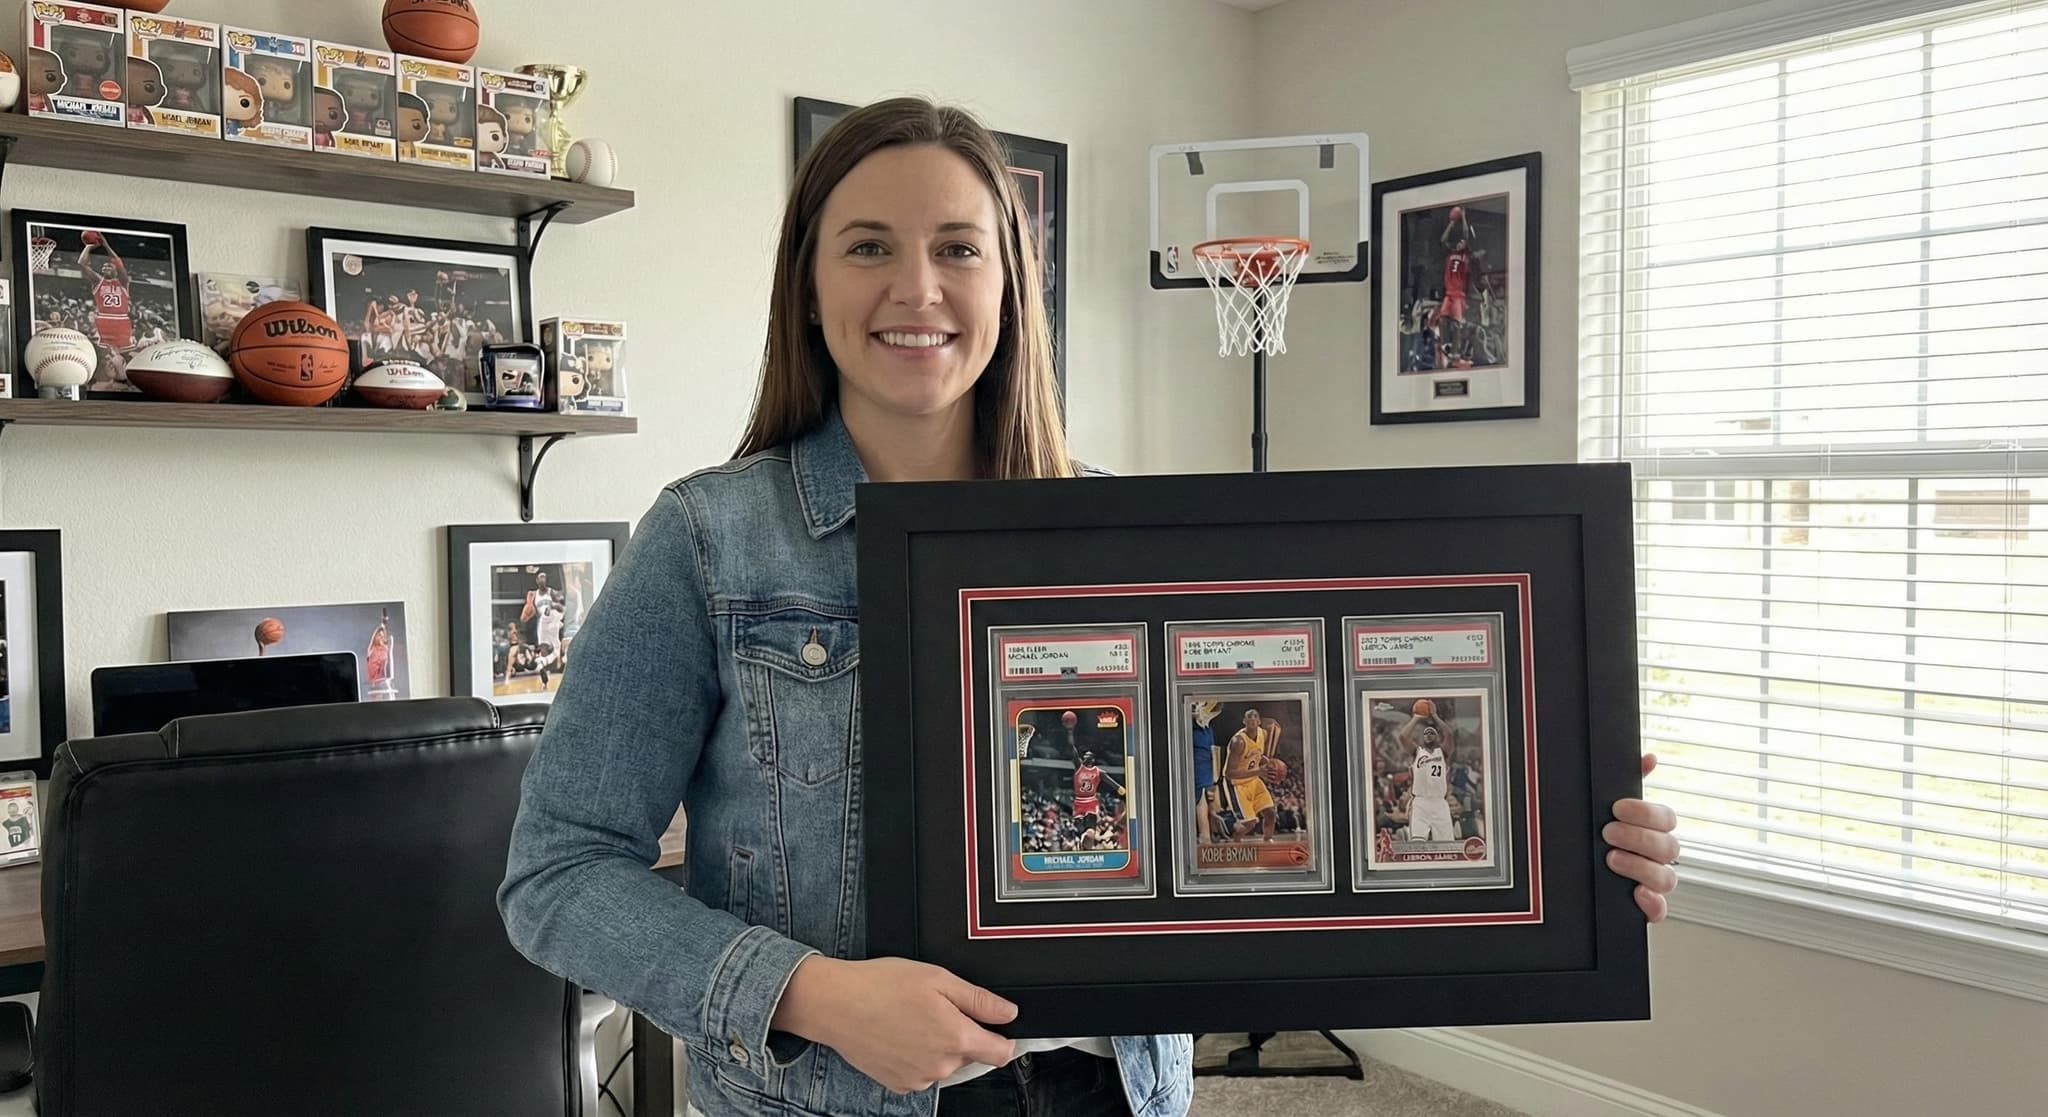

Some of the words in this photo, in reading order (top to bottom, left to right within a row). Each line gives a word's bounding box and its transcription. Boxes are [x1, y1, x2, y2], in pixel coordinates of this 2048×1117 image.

[264, 318, 339, 341] Wilson
[1044, 855, 1074, 864] MICHAEL
[1077, 854, 1104, 863] JORDAN
[1201, 848, 1224, 863] KOBE
[1226, 847, 1258, 862] BRYANT
